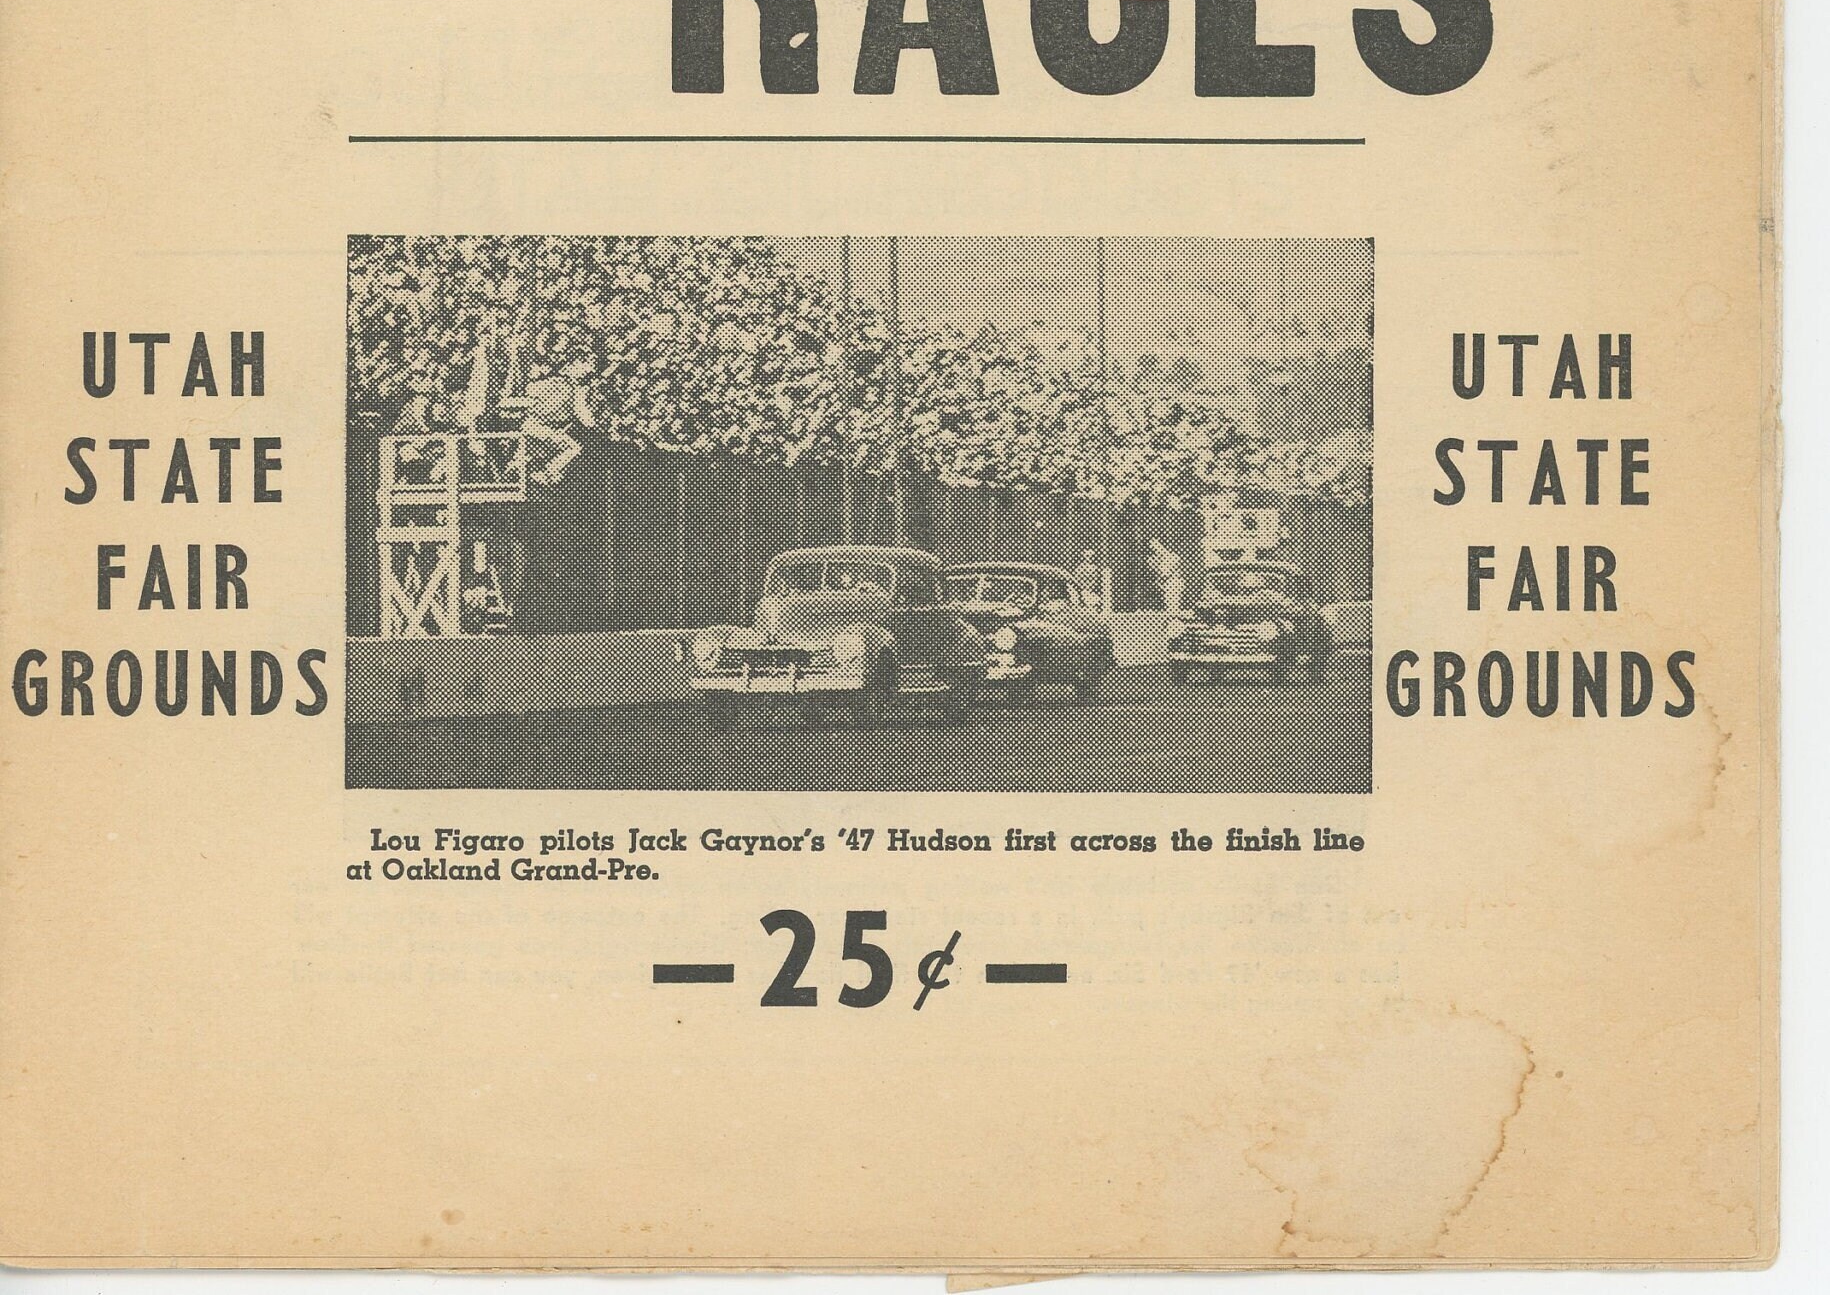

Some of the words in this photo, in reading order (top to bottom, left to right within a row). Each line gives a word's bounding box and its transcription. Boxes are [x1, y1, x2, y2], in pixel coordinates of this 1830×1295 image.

[83, 331, 265, 399] UTAH
[1452, 333, 1632, 400] UTAH
[64, 437, 283, 505] STATE
[1433, 437, 1650, 506] STATE
[97, 544, 250, 610] FAIR
[1467, 545, 1618, 612] FAIR
[11, 648, 330, 717] GROUNDS
[1386, 649, 1699, 718] GROUNDS
[346, 859, 372, 881] at
[382, 857, 501, 881] Oakland
[511, 857, 660, 881] Grand-Pre.
[370, 828, 421, 852] Lou
[434, 828, 524, 856] Figaro
[540, 828, 614, 856] pilots
[628, 828, 687, 853] Jack
[700, 828, 825, 856] Gaynor's
[887, 828, 992, 852] Hudson
[1004, 828, 1056, 852] first
[1070, 834, 1157, 853] across
[1170, 828, 1213, 852] the
[1226, 827, 1301, 852] finish
[1313, 827, 1365, 852] line
